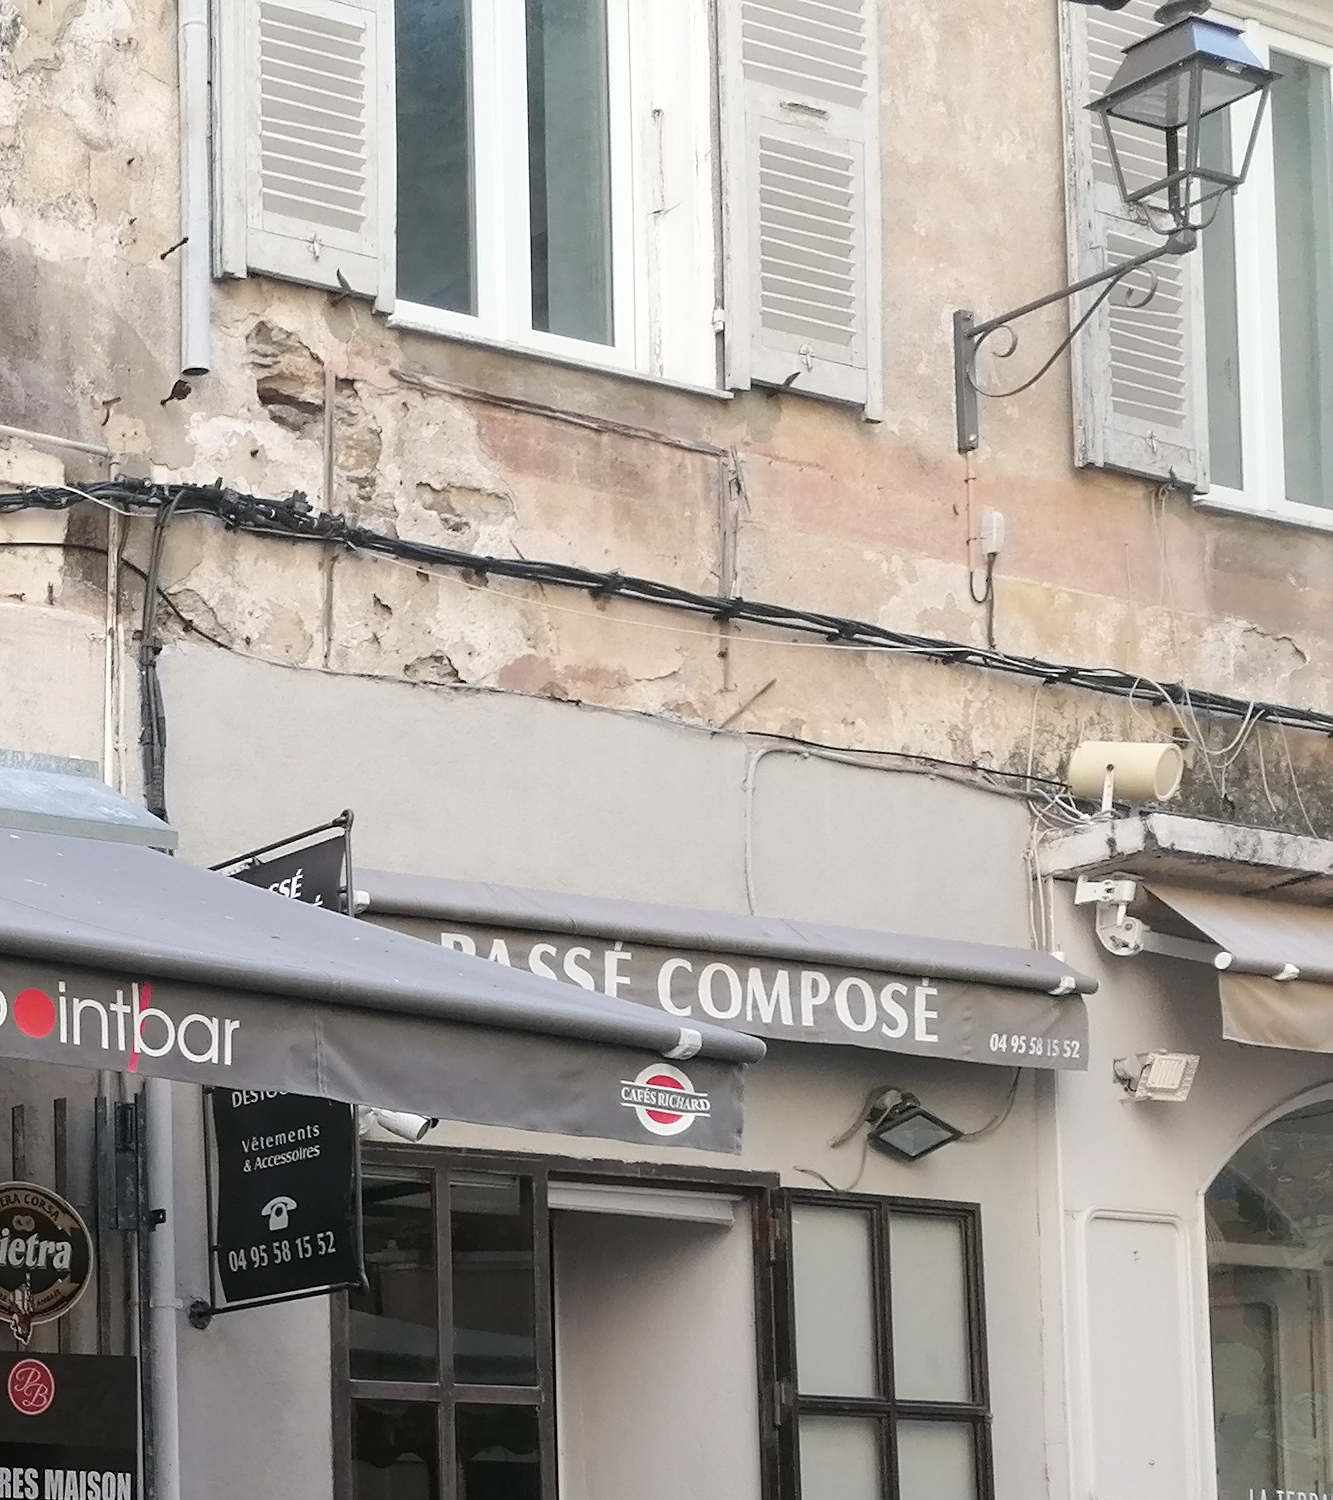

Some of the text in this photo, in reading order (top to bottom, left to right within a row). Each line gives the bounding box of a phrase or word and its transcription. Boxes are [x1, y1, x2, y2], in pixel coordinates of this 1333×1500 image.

[657, 958, 940, 1043] COMPOSÉ
[989, 1034, 1081, 1059] 04 95 58 15 52
[620, 1086, 711, 1111] CAFÉS RICHARD
[241, 1124, 321, 1153] Vêtements
[243, 1145, 321, 1173] & Accessoires
[23, 1194, 62, 1222] CORSA
[228, 1230, 336, 1272] 04 95 58 15 52
